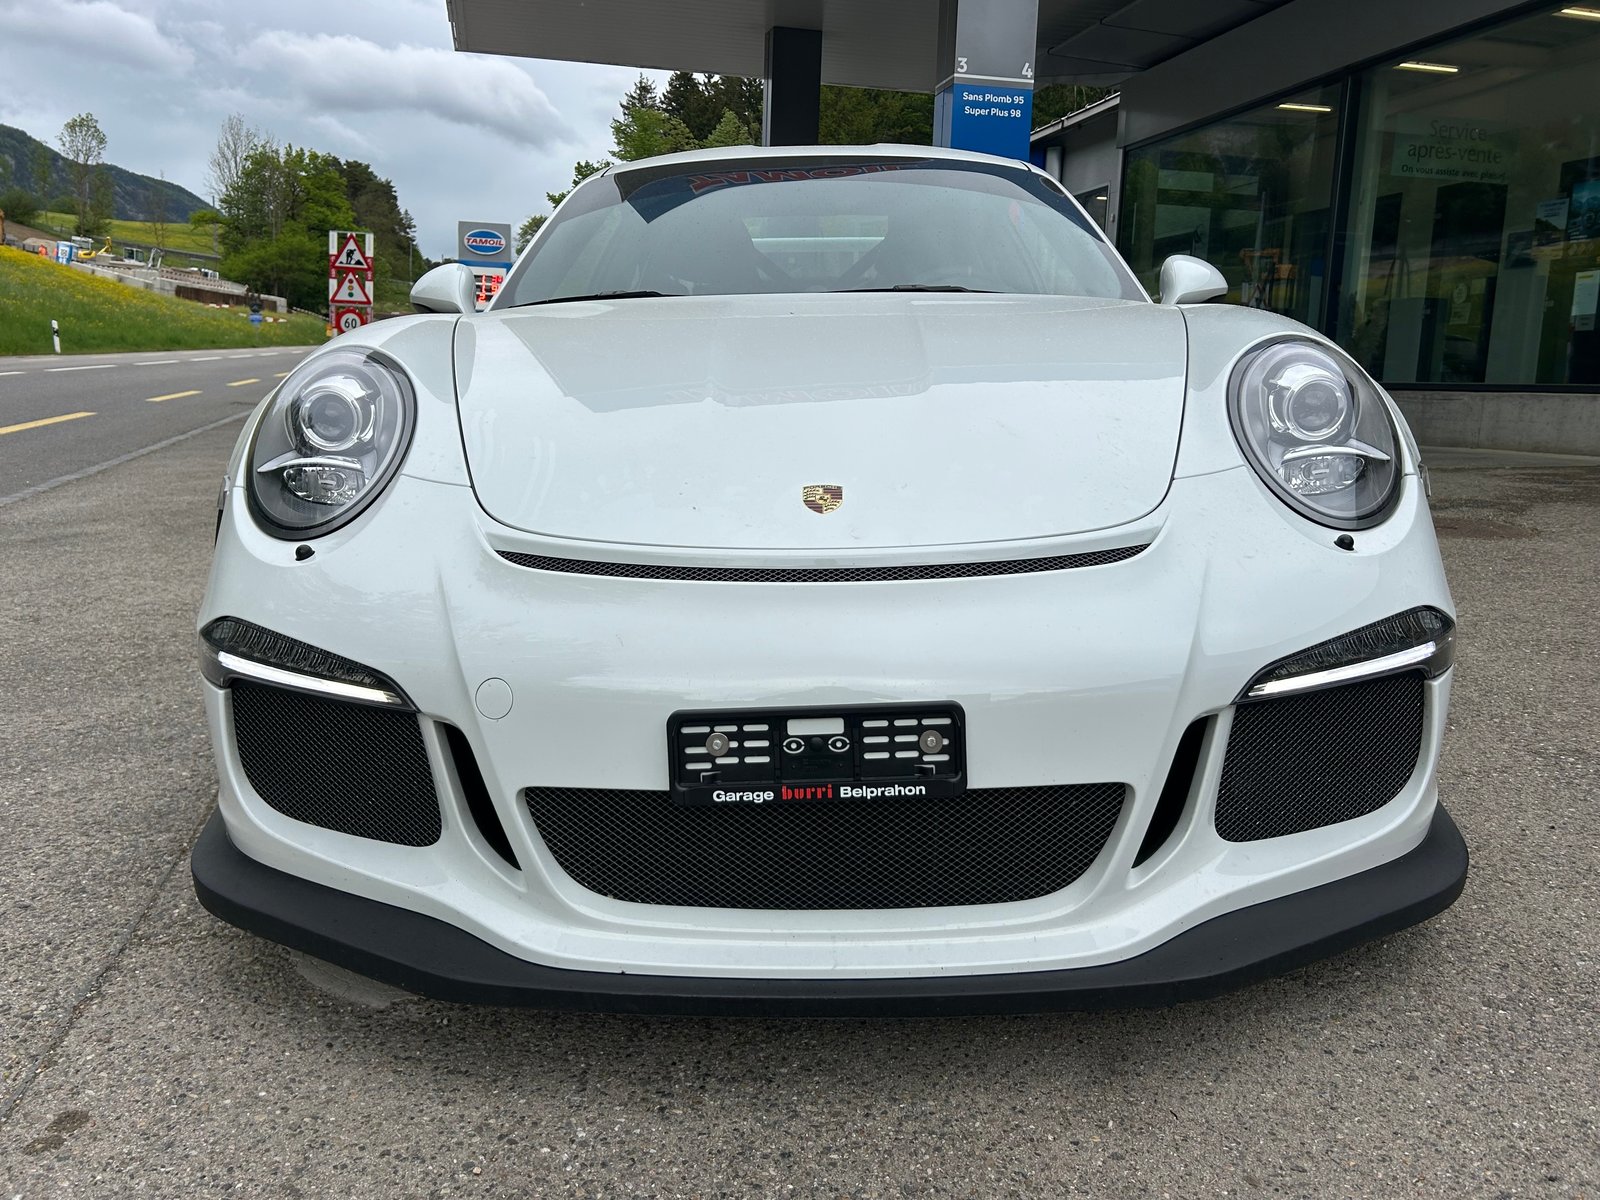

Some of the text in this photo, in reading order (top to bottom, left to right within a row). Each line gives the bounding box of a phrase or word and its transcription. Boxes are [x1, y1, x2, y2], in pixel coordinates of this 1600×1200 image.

[957, 57, 967, 72] 3
[1022, 63, 1033, 78] 4
[963, 92, 1024, 104] Sans Plomb 95
[964, 106, 1021, 117] Super Plus 98
[1429, 119, 1488, 142] Service
[1407, 141, 1503, 164] après-vente
[1401, 164, 1414, 173] On
[1415, 166, 1433, 175] vous
[466, 238, 504, 246] TAMOIL
[344, 318, 357, 329] 60
[712, 784, 926, 803] Garage burri Belprahon
